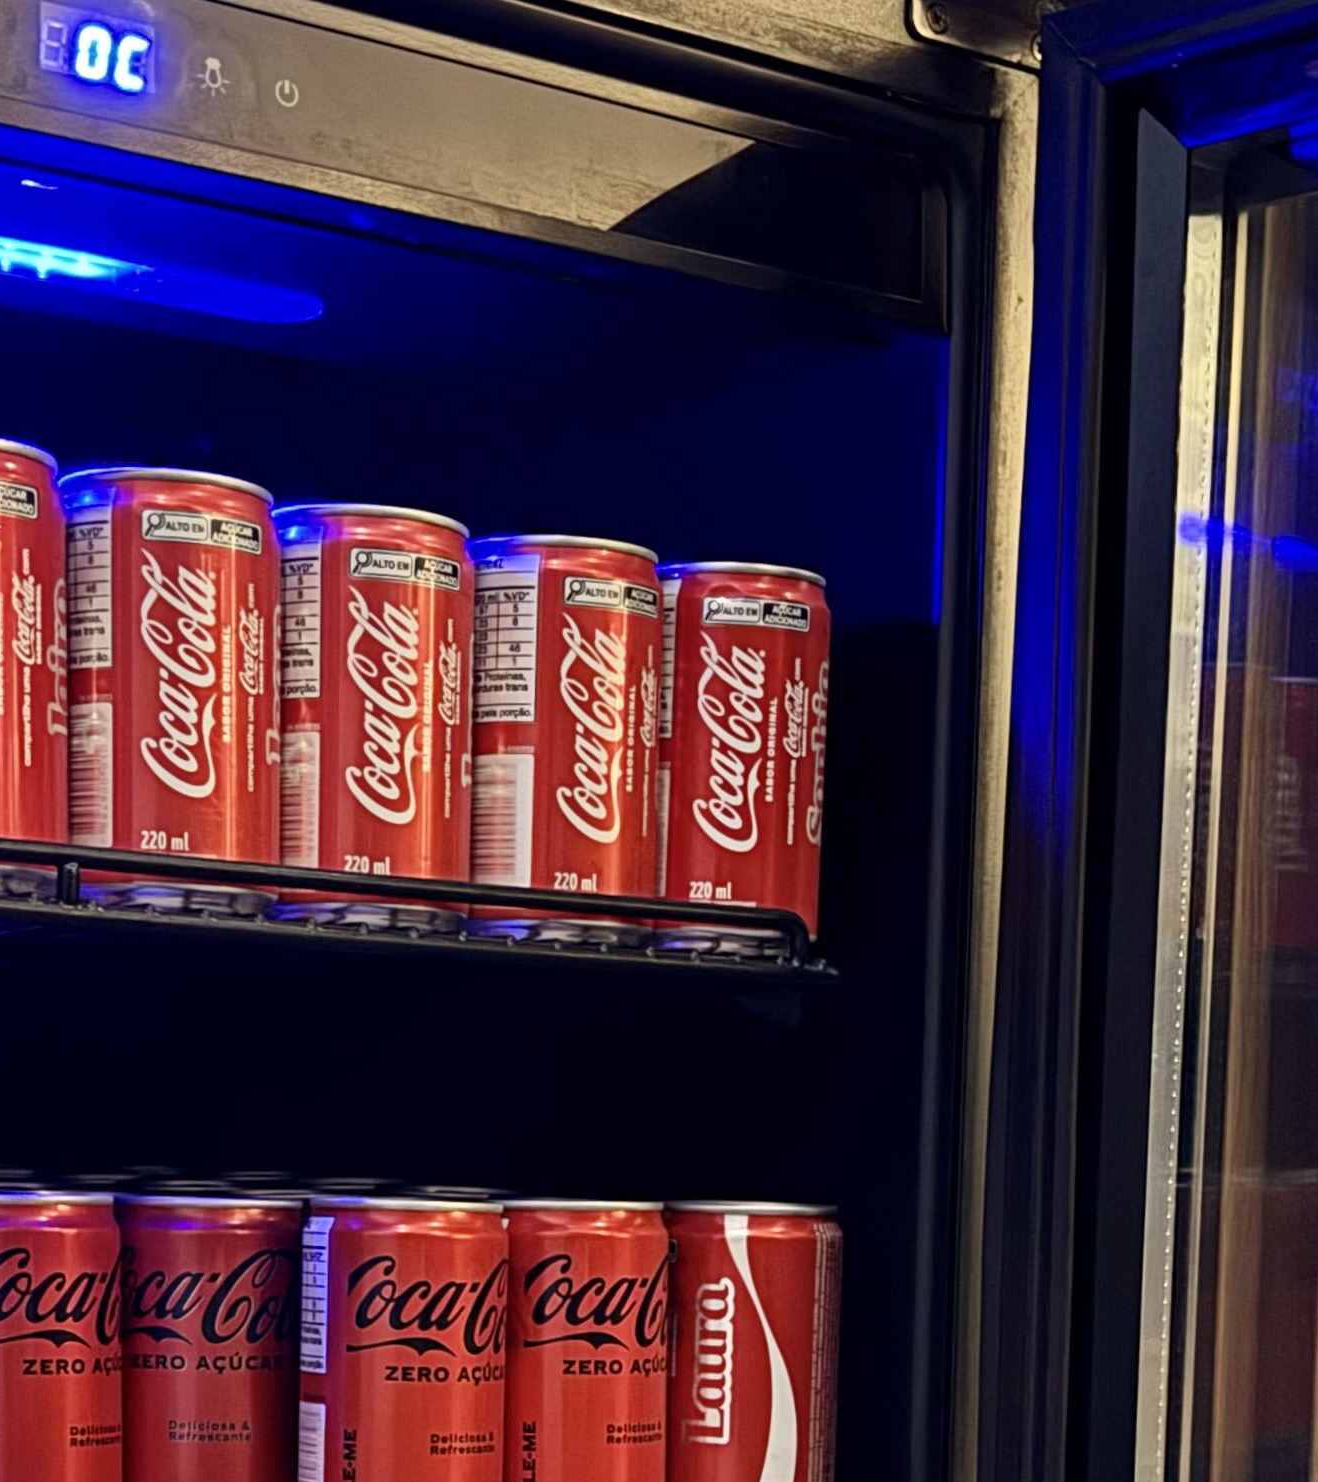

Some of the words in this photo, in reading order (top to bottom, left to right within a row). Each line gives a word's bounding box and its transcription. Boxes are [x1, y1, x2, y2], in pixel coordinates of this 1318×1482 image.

[165, 521, 190, 531] ALTO
[373, 559, 394, 569] ALTO
[586, 588, 606, 598] ALTO
[723, 607, 743, 616] ALTO
[222, 626, 232, 699] ORIGINAL
[140, 547, 217, 799] Coca-Cola
[345, 585, 420, 826] Coca-Cola
[222, 704, 232, 744] SABOR
[556, 611, 626, 844] Coca-Cola
[627, 684, 636, 752] ORIGINAL
[767, 698, 777, 757] ORIGINAL
[693, 631, 766, 853] Coca-Cola
[765, 760, 774, 802] SABOR
[140, 831, 167, 850] 220
[171, 831, 189, 852] ml
[344, 855, 368, 875] 220
[554, 872, 578, 890] 220
[581, 873, 597, 892] ml
[689, 881, 712, 900] 220
[715, 881, 732, 900] ml
[23, 1359, 86, 1376] ZERO
[130, 1354, 186, 1370] ZERO
[562, 1359, 624, 1377] ZERO
[384, 1365, 449, 1384] ZERO
[168, 1420, 235, 1431] Deliciosa
[169, 1432, 252, 1443] Refrescante
